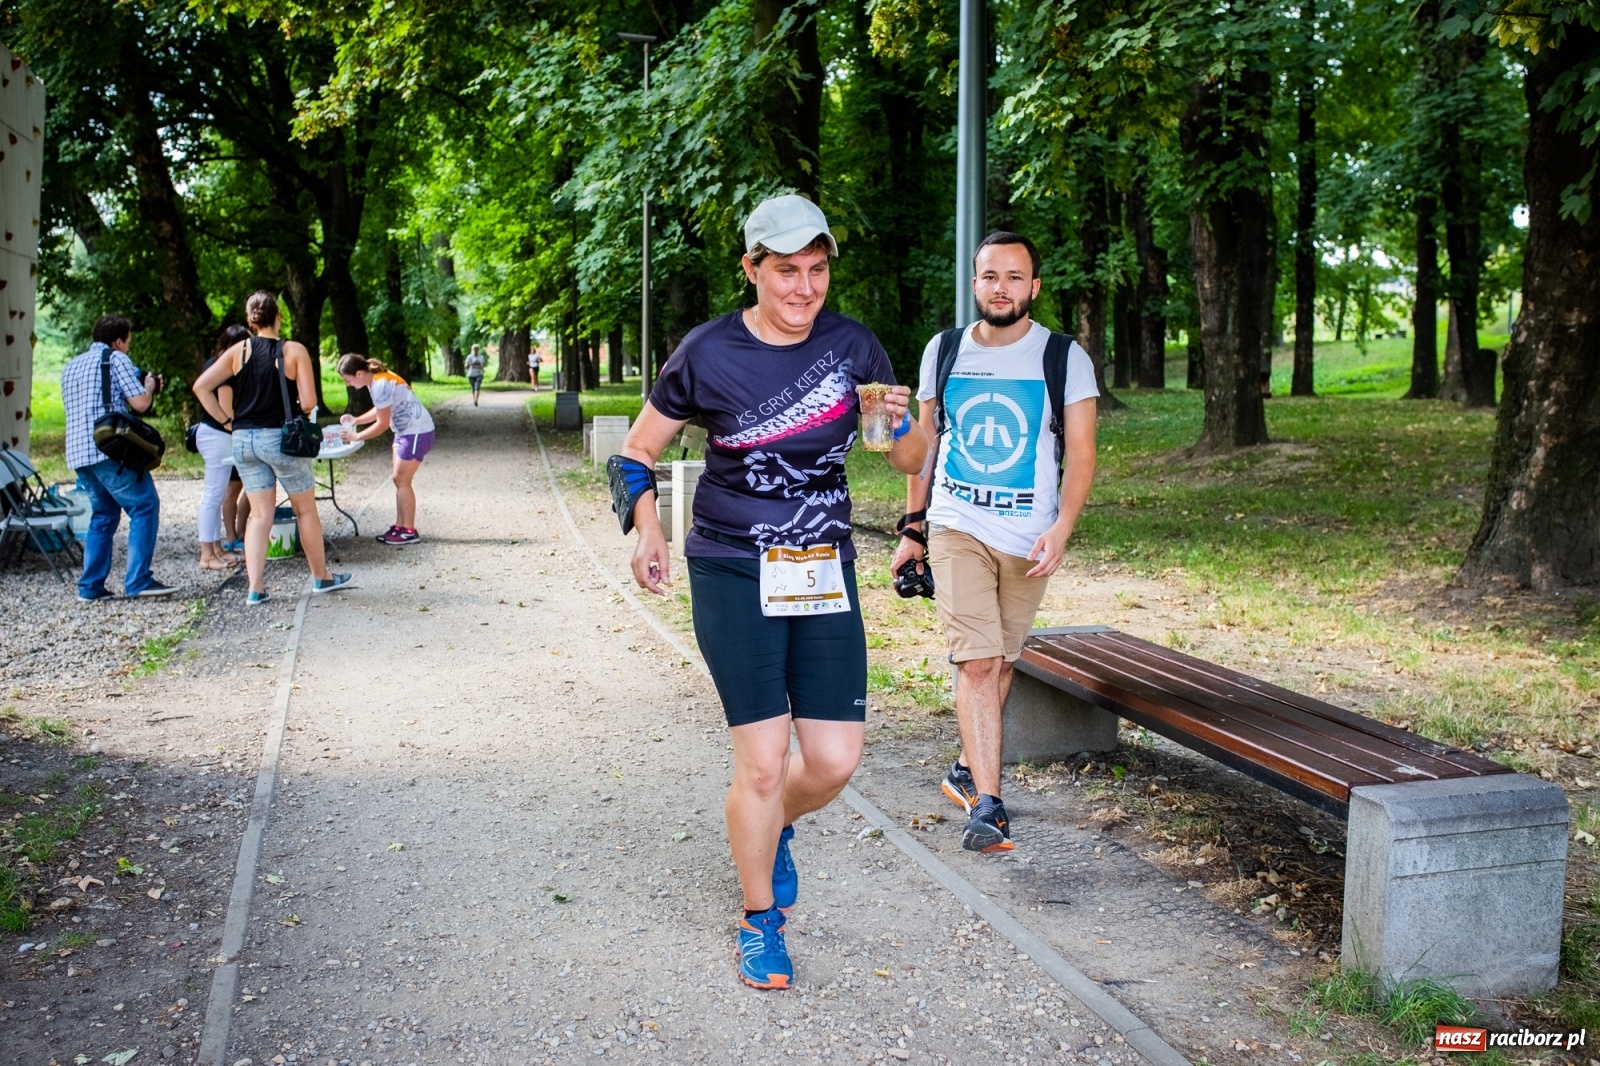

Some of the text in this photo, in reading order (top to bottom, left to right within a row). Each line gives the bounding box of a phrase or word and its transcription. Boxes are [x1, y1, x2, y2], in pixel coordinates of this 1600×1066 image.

[735, 350, 840, 427] KS GRYF KIETRZ
[807, 570, 816, 588] 5
